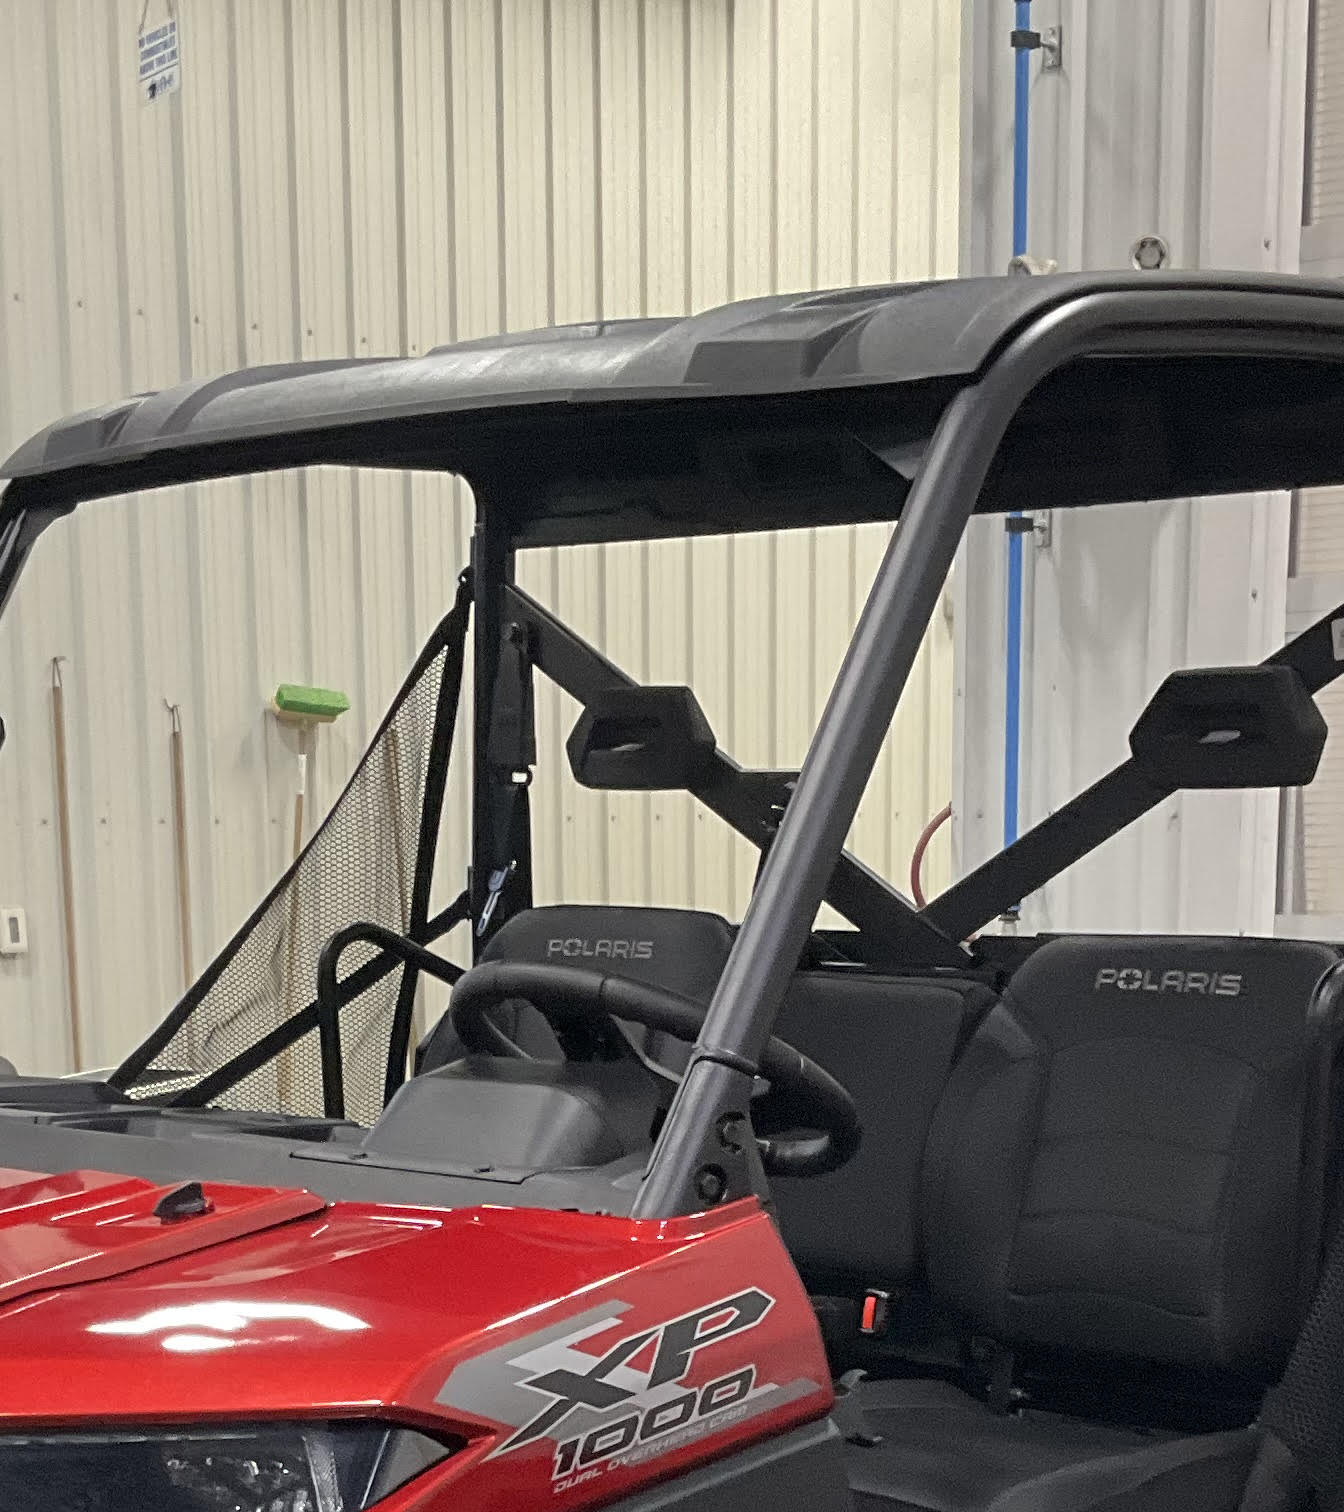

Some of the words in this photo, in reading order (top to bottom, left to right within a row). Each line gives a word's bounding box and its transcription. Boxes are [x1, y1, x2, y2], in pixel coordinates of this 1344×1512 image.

[547, 937, 654, 959] POLARIS
[1094, 968, 1242, 996] POLARIS
[481, 1286, 776, 1463] XP
[551, 1363, 757, 1481] 1000
[553, 1467, 604, 1494] DUAL
